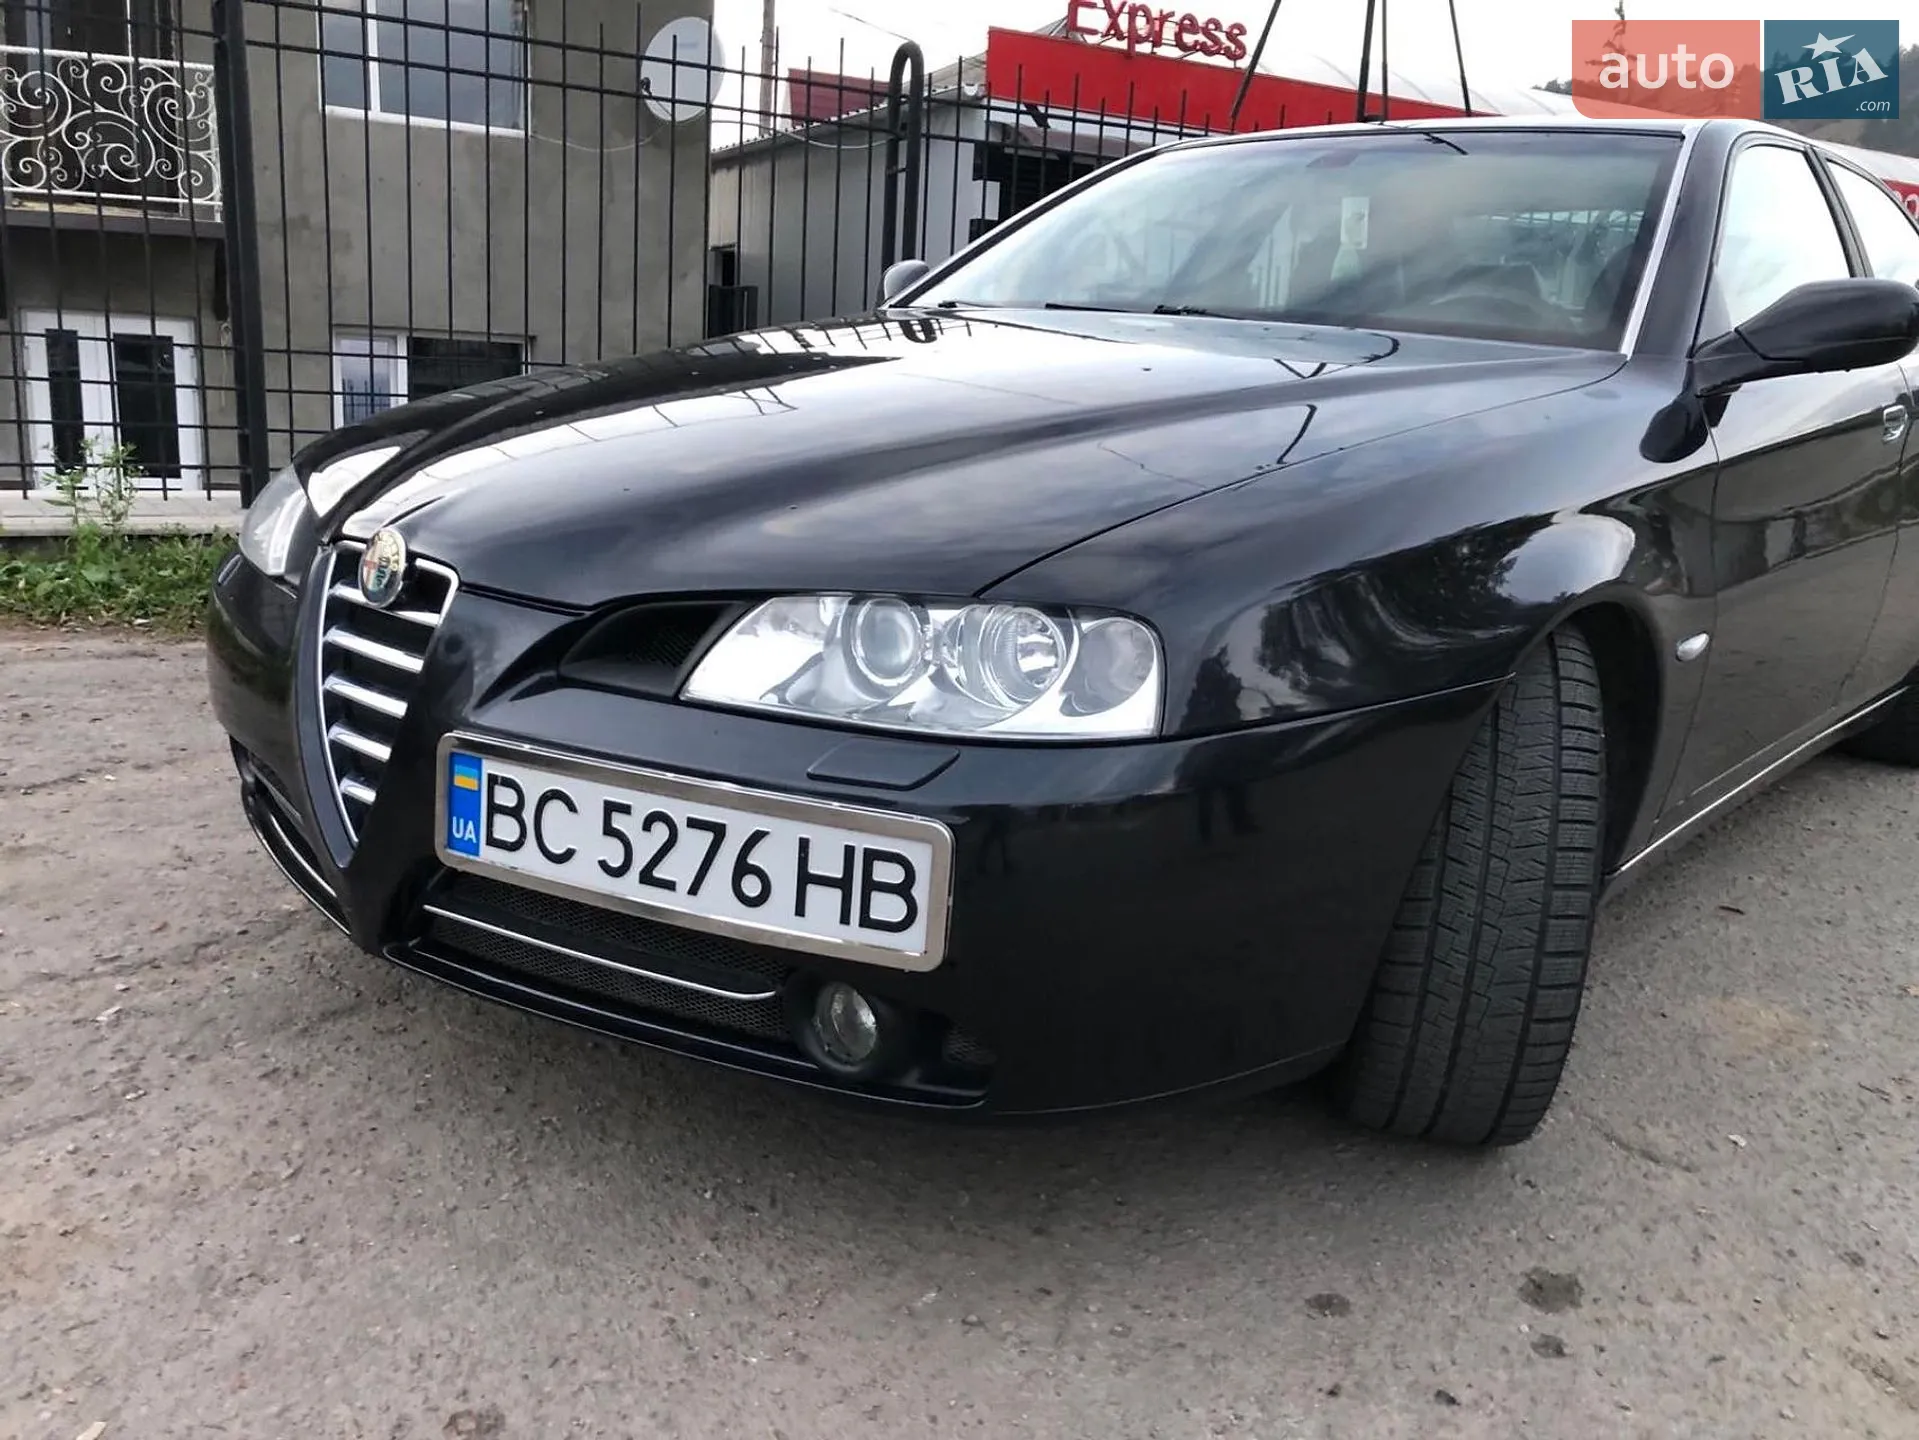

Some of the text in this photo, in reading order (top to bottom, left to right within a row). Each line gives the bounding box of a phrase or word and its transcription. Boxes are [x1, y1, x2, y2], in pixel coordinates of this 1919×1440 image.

[1068, 0, 1247, 60] Express
[452, 816, 477, 843] UA
[486, 772, 919, 933] BC 5276 HB
